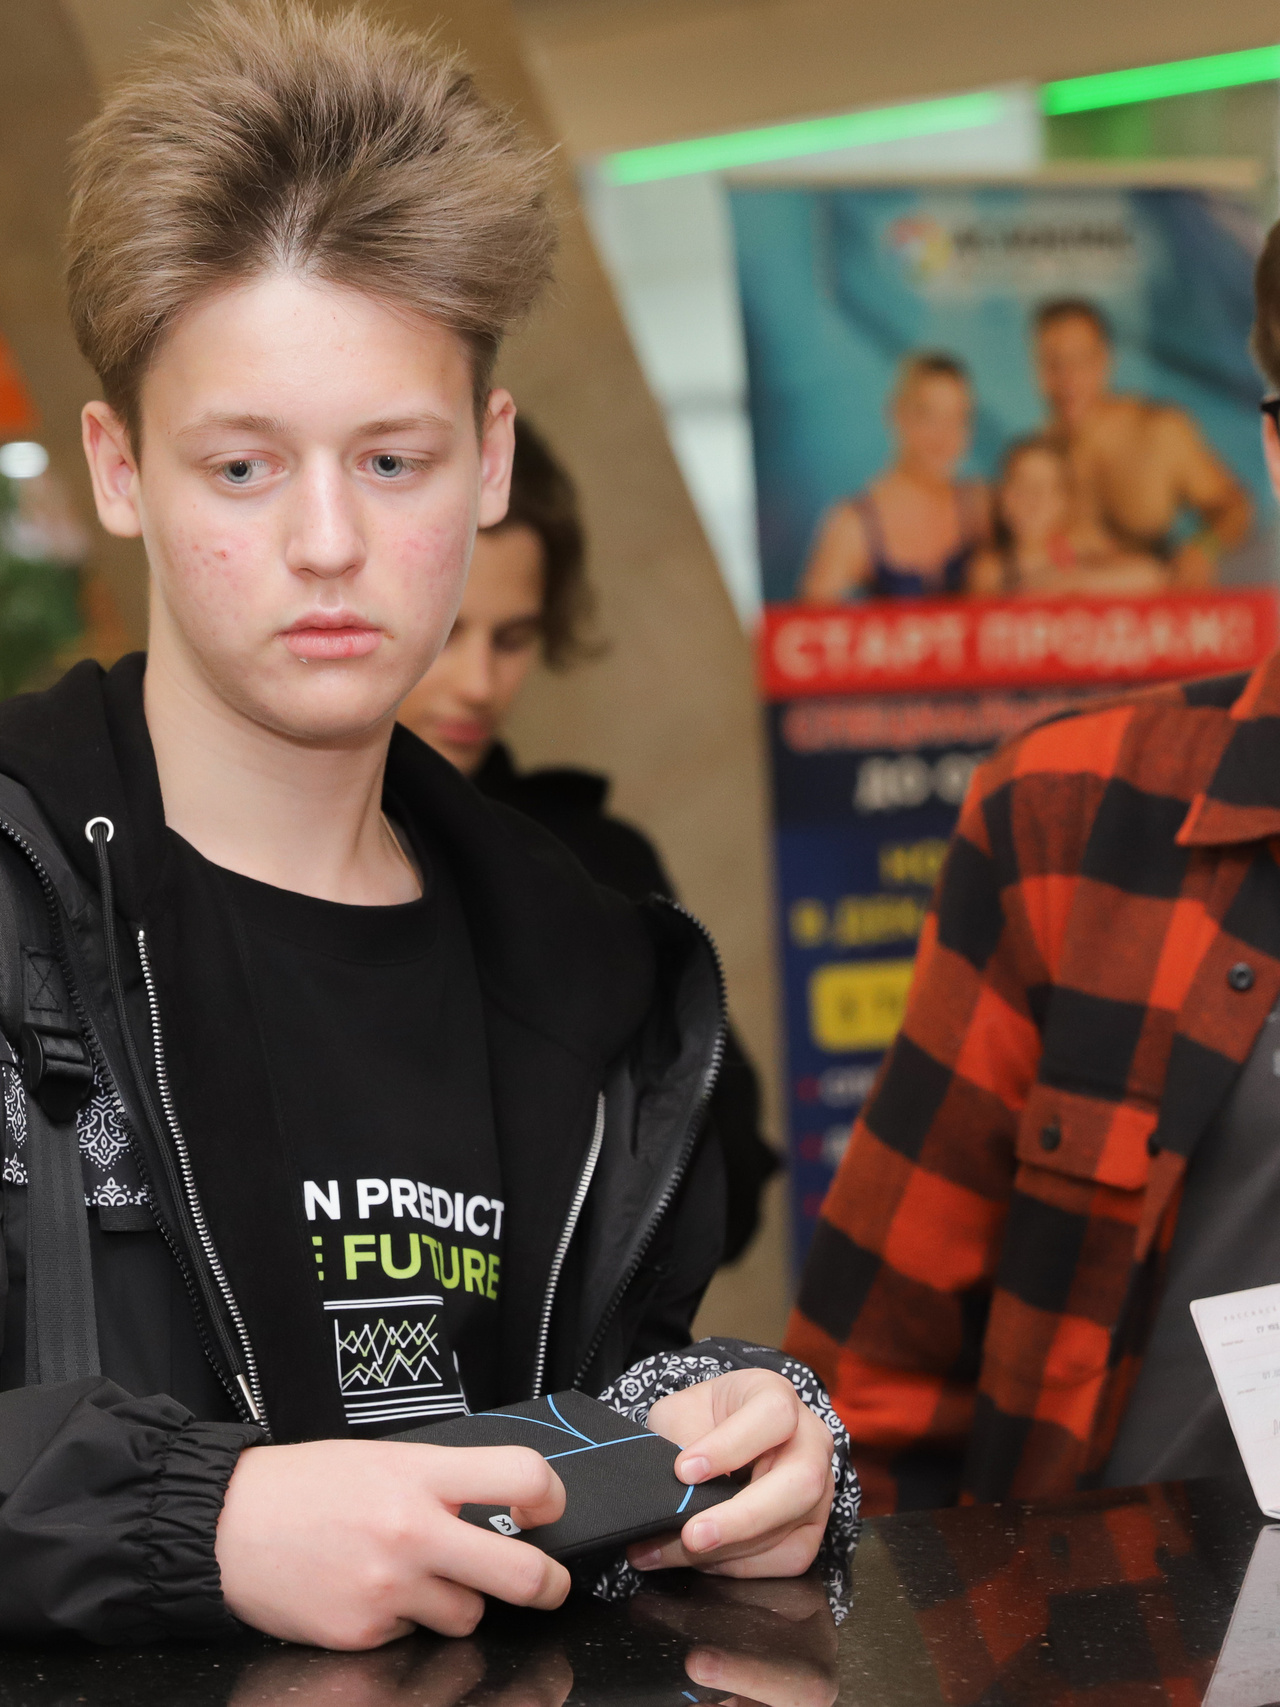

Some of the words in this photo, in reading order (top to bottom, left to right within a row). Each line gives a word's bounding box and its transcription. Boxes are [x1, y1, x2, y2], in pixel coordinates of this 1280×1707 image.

[772, 613, 967, 681] СТАРТ
[356, 1177, 505, 1240] PREDICT
[343, 1232, 500, 1301] FUTURE
